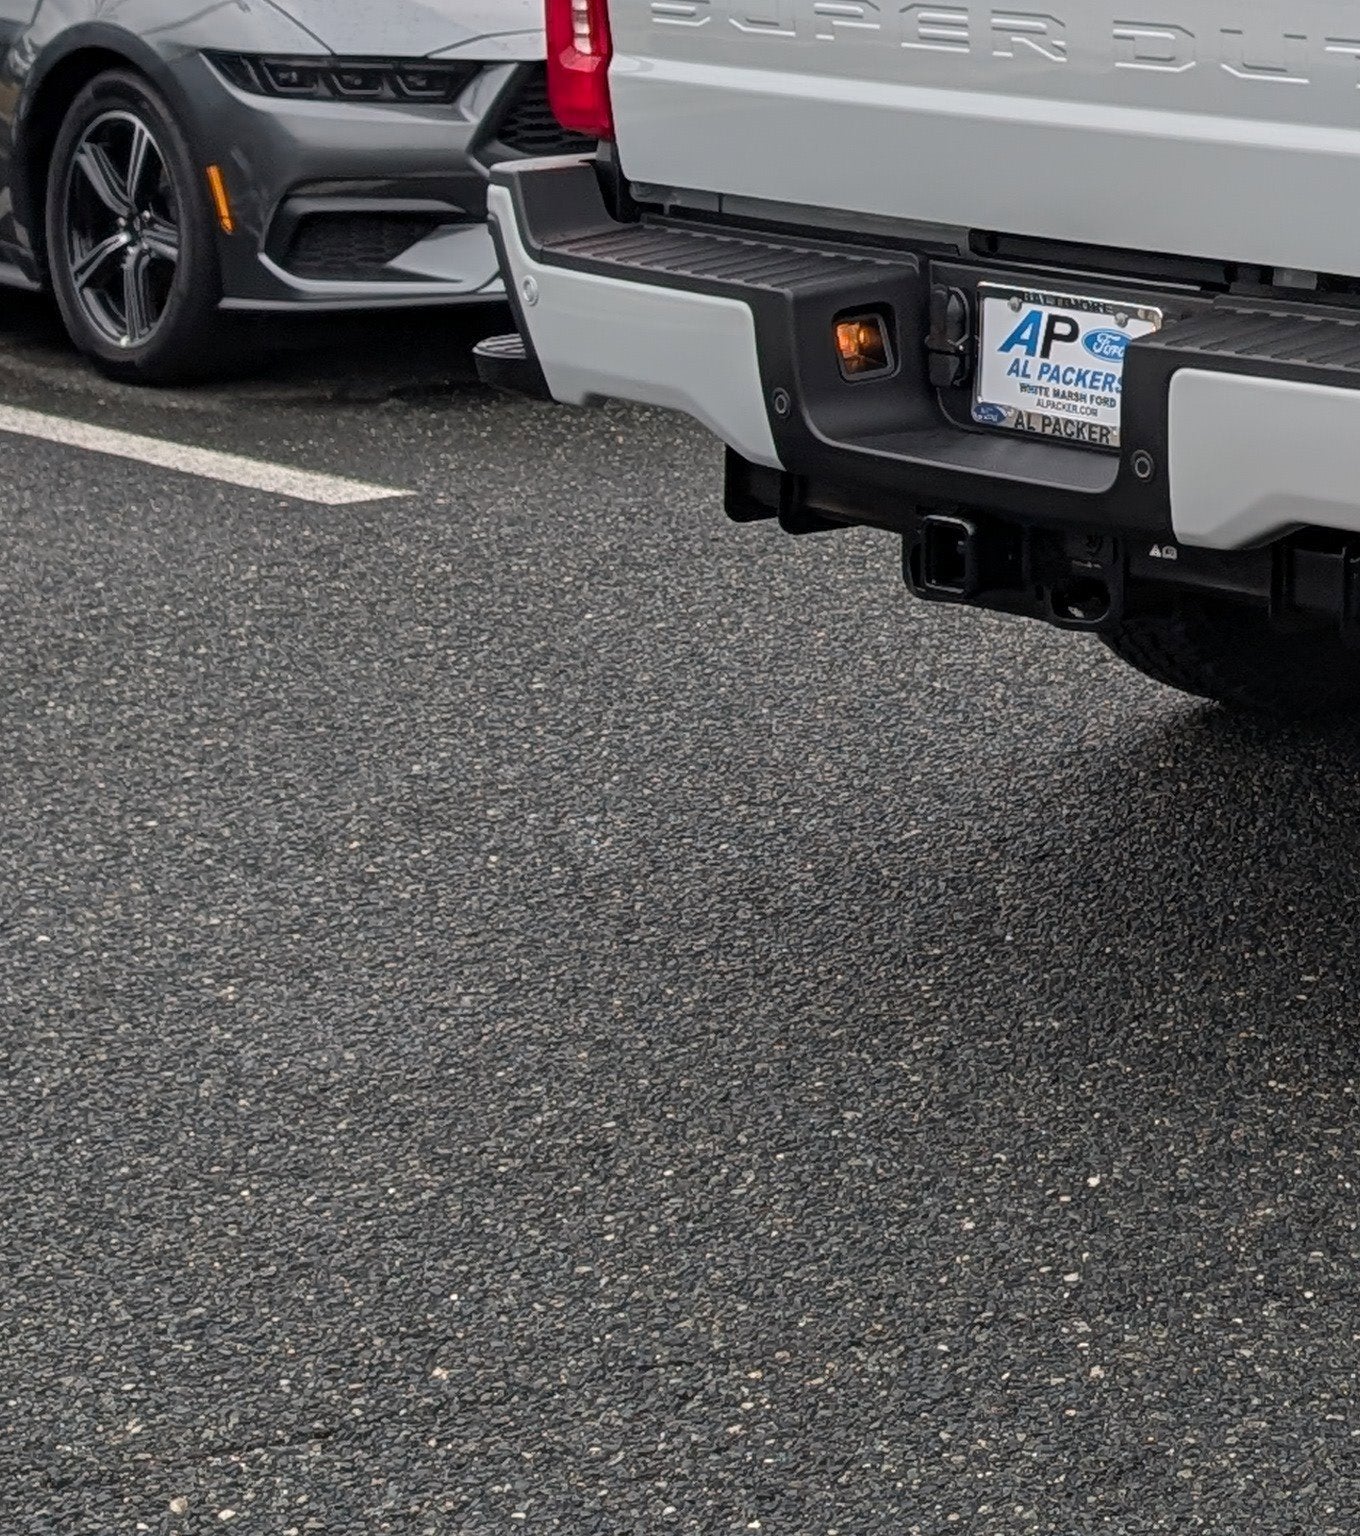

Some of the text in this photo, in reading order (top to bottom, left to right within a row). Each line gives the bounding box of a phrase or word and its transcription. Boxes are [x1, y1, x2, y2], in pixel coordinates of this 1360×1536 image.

[997, 309, 1080, 359] AP
[1006, 357, 1031, 379] AL
[1019, 382, 1117, 408] WHITE MARSH FORD
[1014, 409, 1036, 431] AL
[1041, 414, 1111, 444] PACKER
